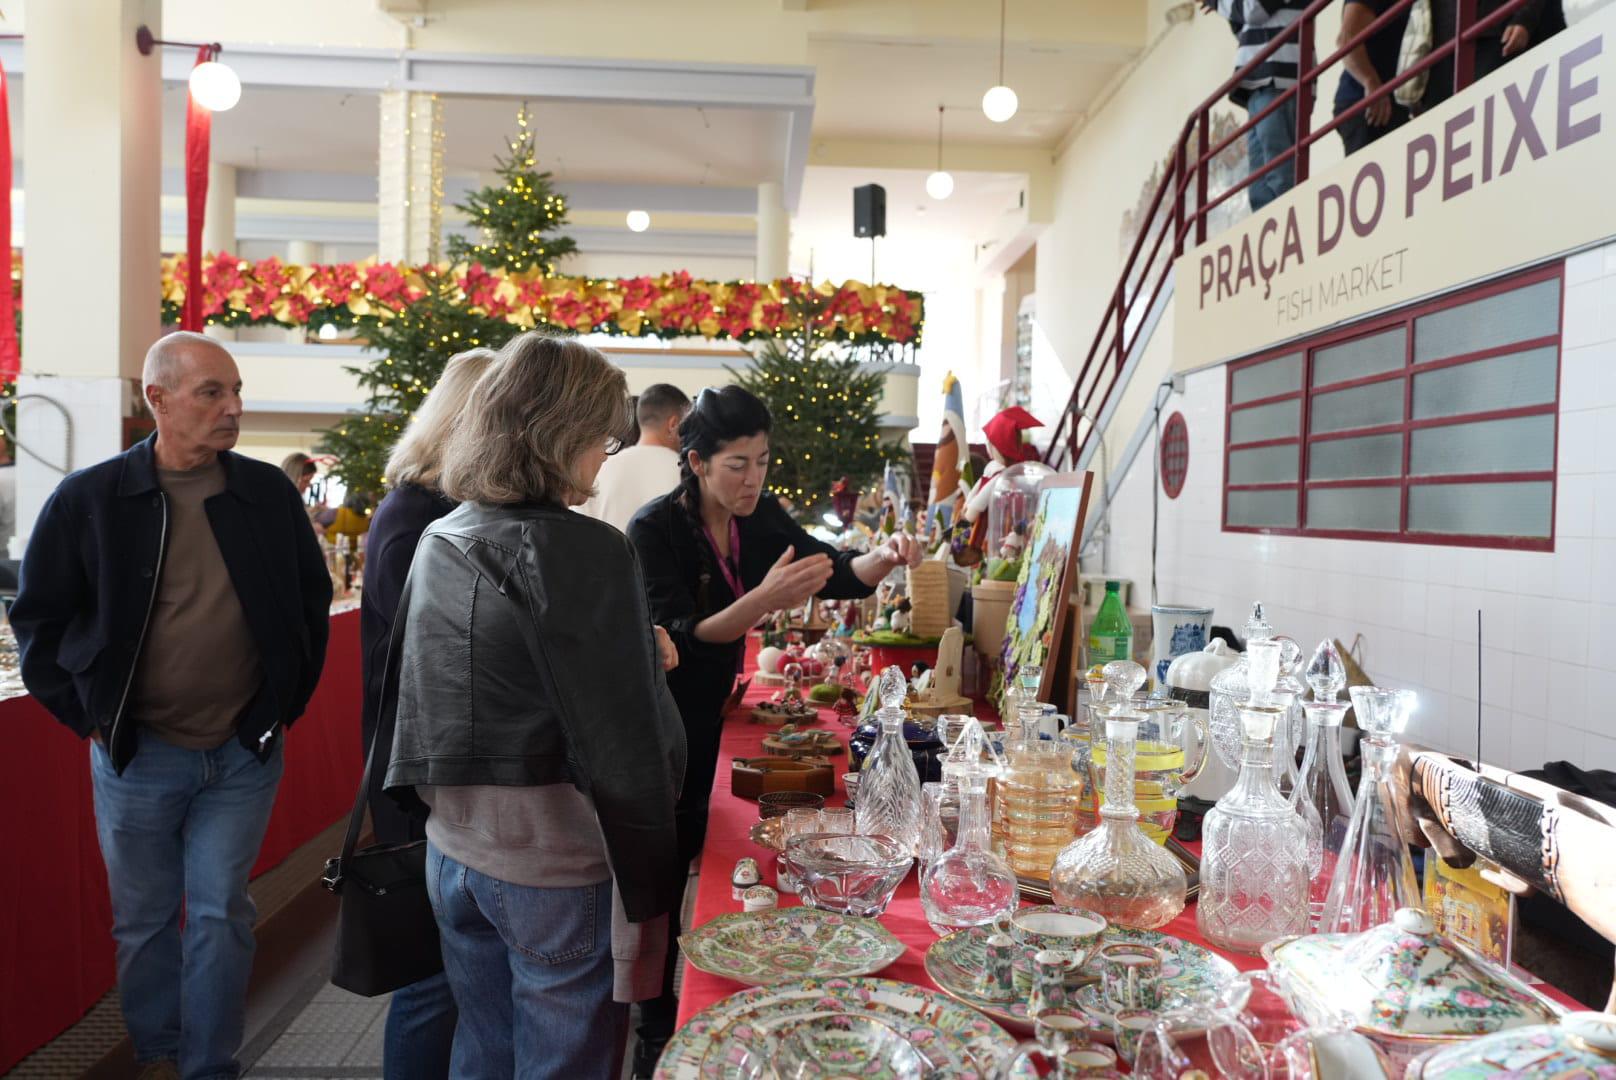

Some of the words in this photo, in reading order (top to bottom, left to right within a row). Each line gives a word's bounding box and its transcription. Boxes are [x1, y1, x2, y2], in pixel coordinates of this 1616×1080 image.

[1200, 205, 1304, 310] PRAÇA
[1317, 161, 1386, 256] DO
[1405, 34, 1603, 219] PEIXE
[1277, 285, 1313, 327] FISH
[1319, 248, 1409, 313] MARKET
